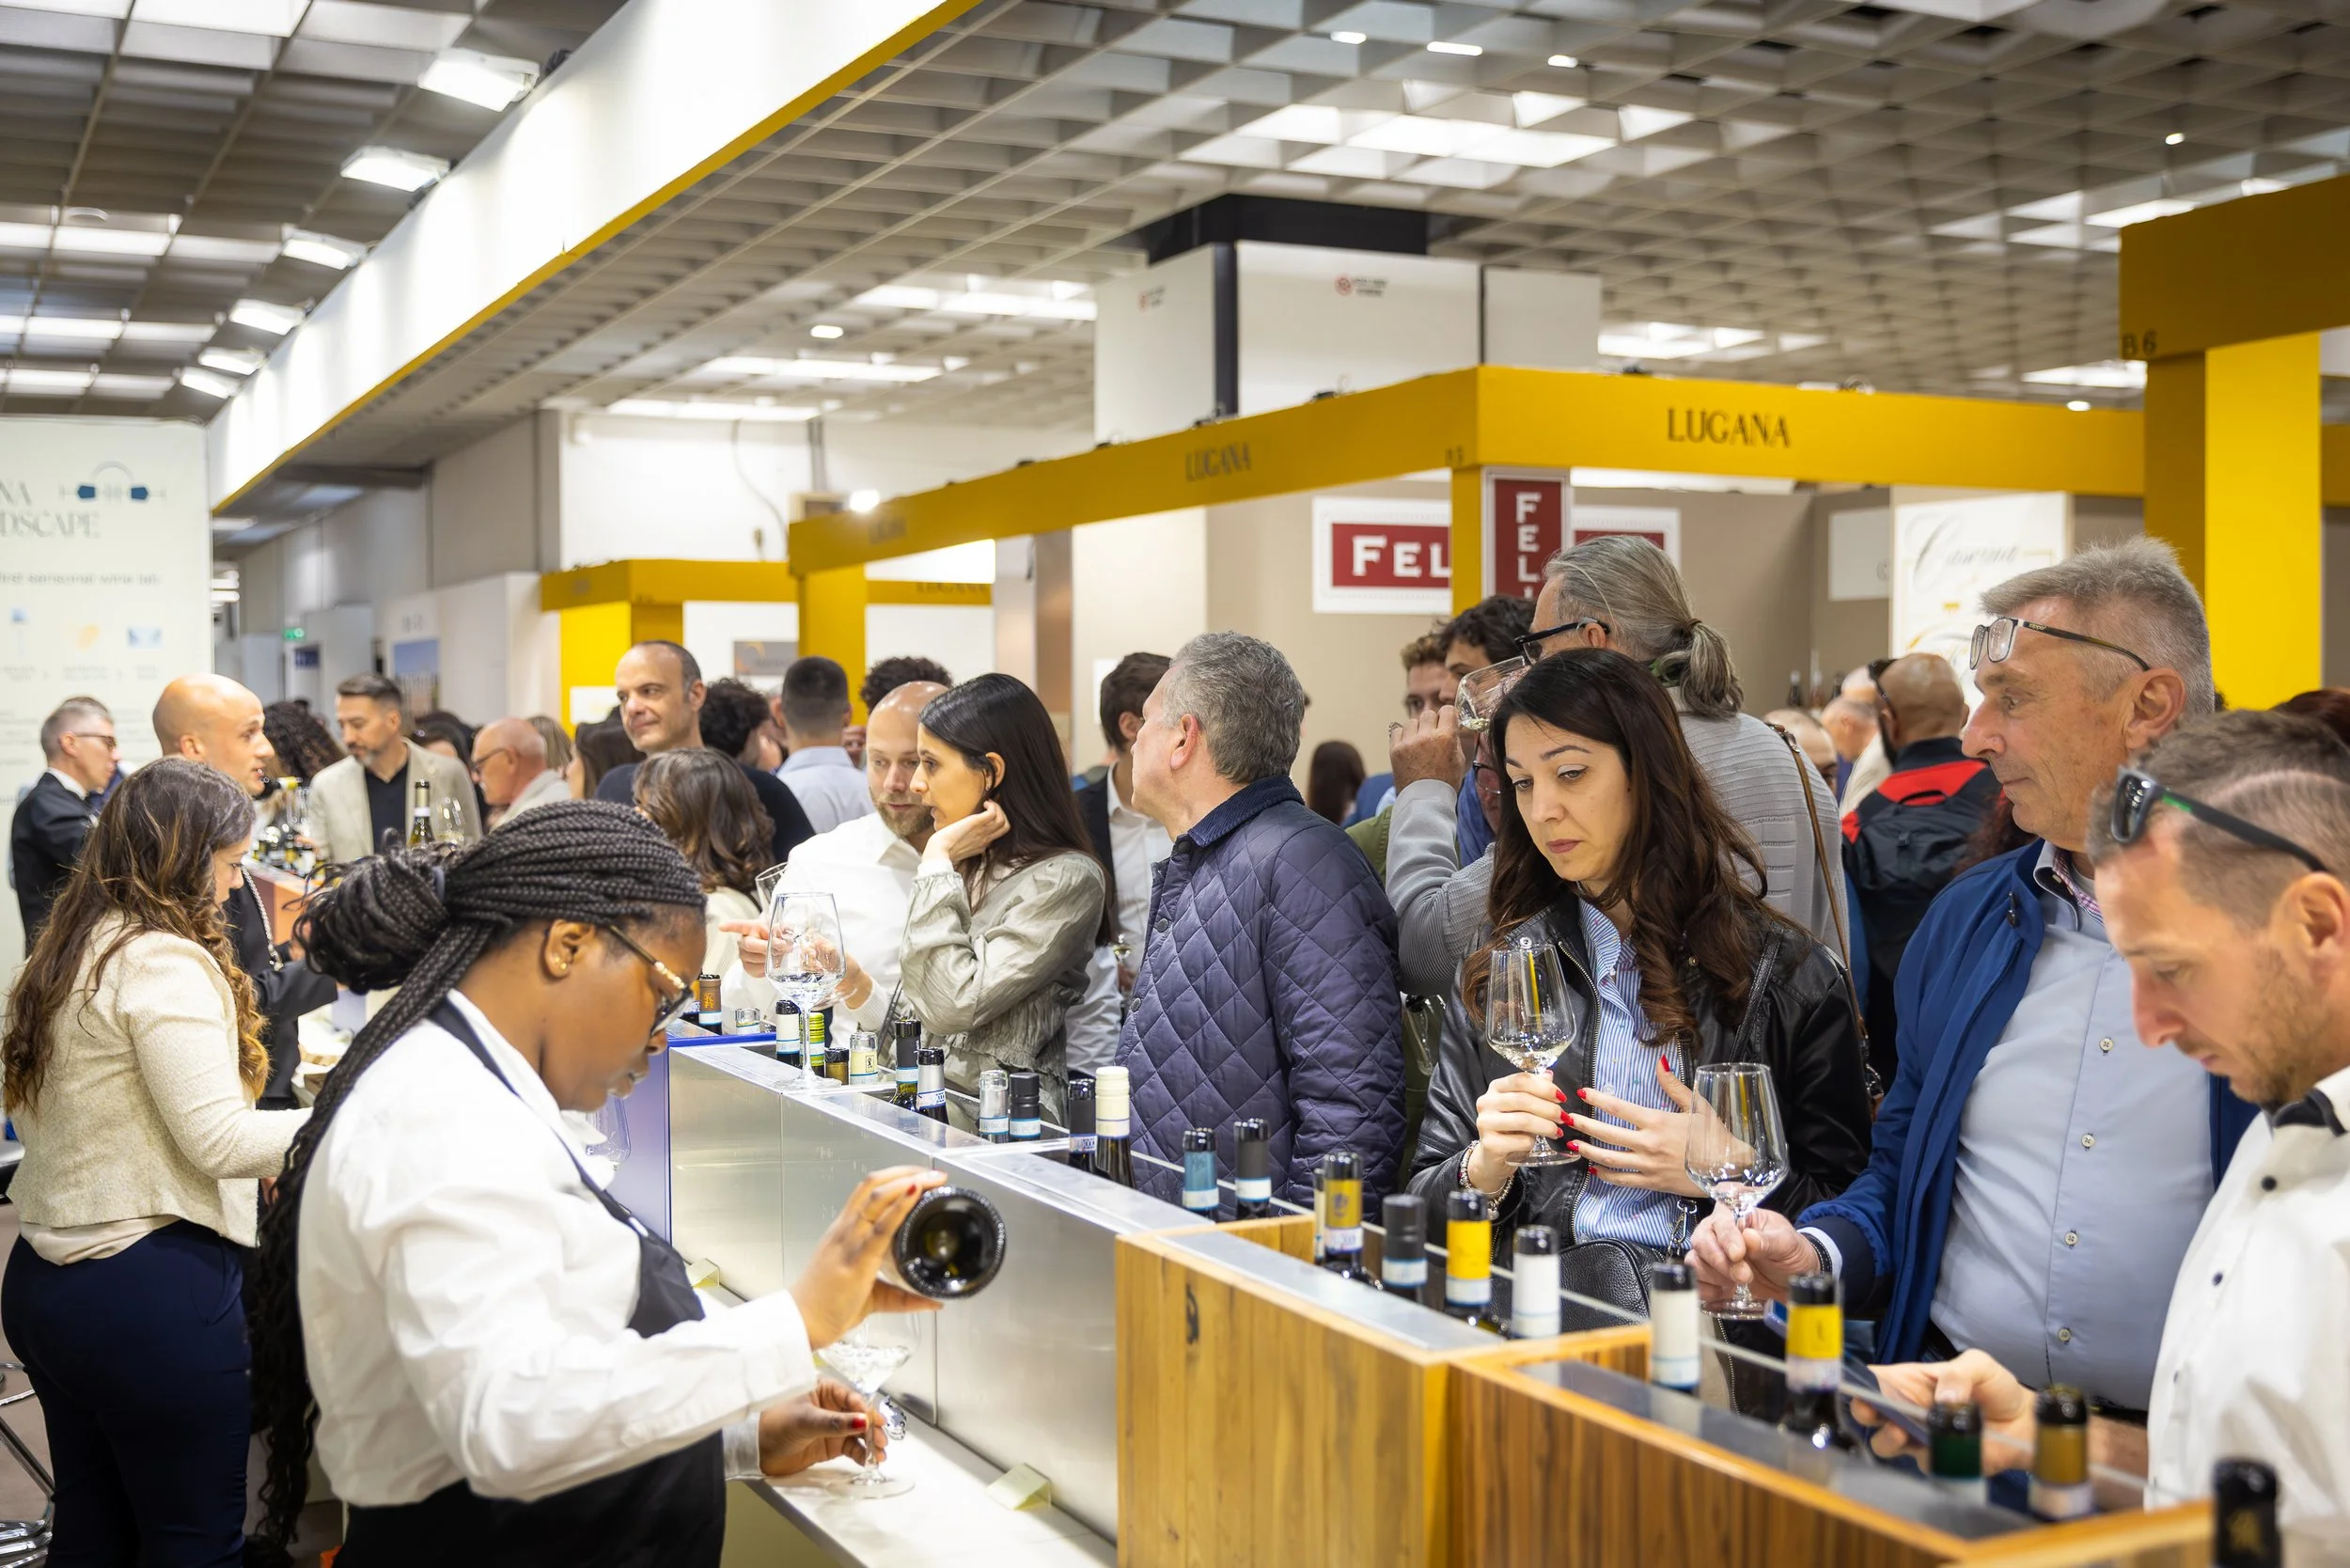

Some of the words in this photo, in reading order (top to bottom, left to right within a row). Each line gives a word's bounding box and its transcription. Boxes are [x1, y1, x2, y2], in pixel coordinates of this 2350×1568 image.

[1668, 406, 1791, 447] LUGANA
[1184, 442, 1252, 482] LUGANA
[1352, 534, 1452, 579] FEL
